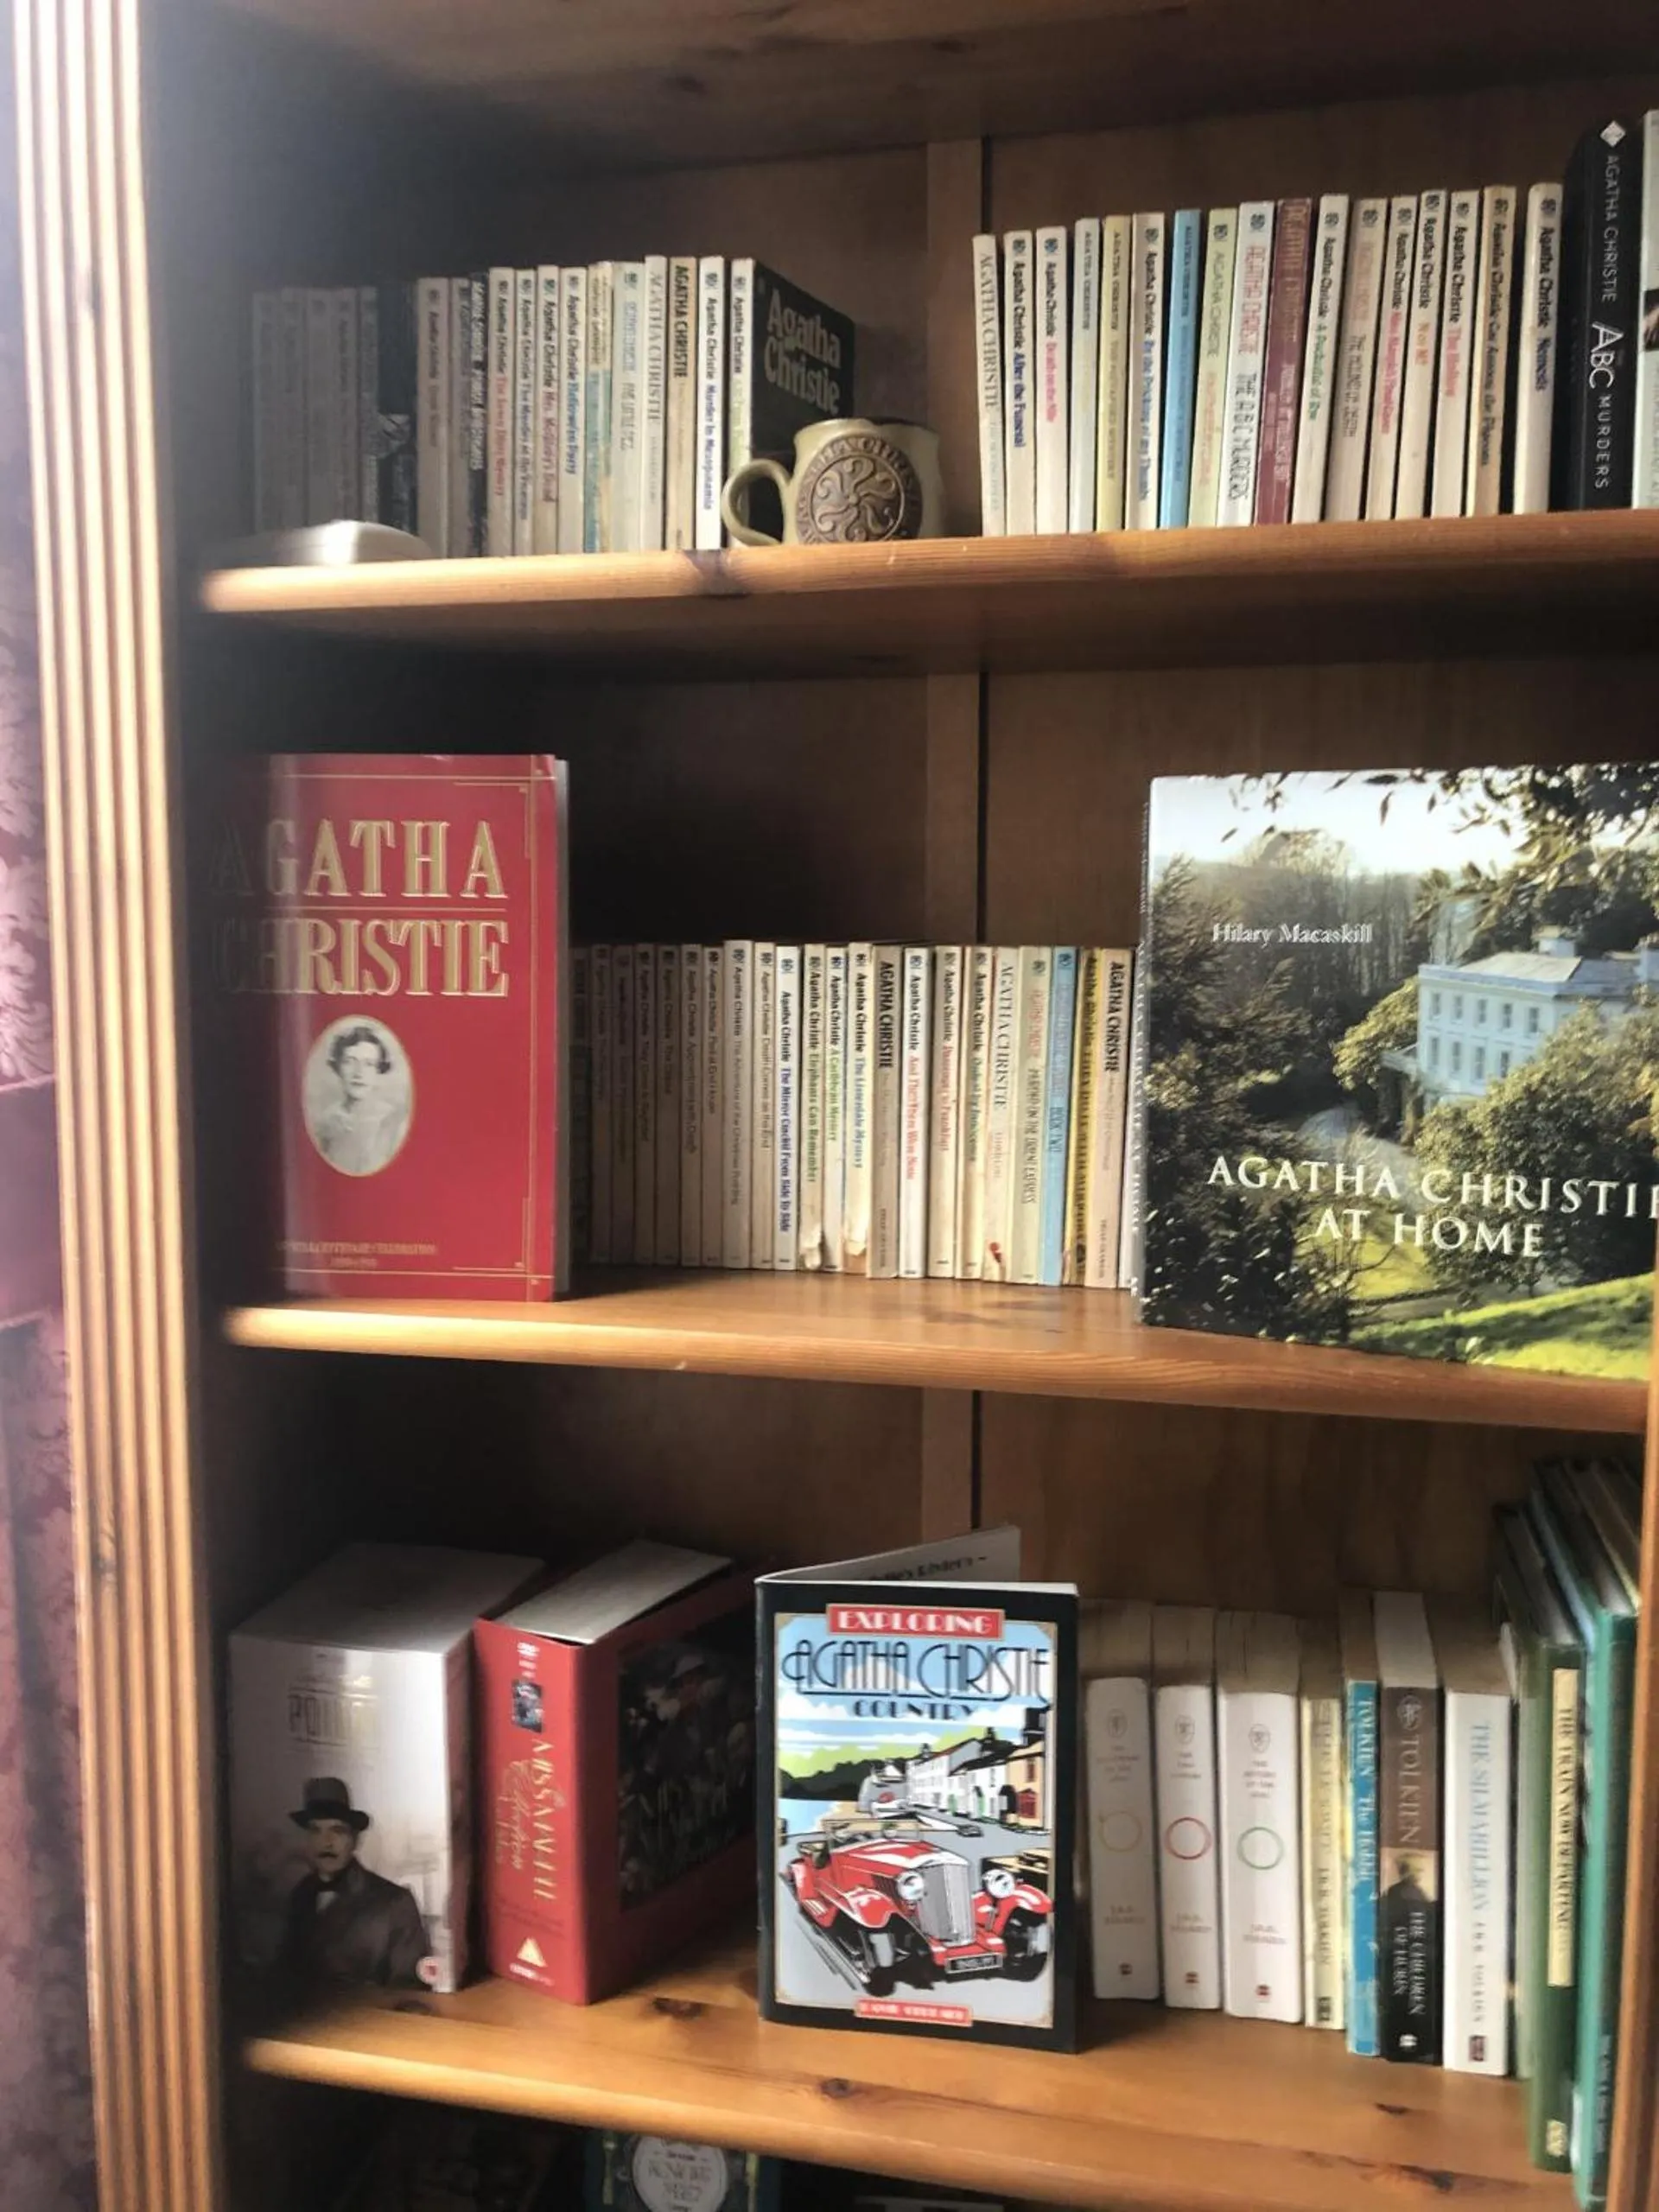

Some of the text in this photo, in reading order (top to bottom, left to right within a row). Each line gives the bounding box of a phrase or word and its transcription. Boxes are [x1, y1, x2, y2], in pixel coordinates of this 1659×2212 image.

[1452, 226, 1471, 270] Agatha
[674, 264, 693, 319] AGATHA
[980, 251, 998, 326] AGATHA
[1013, 261, 1027, 304] Agatha
[1448, 273, 1465, 324] Christie
[1532, 226, 1556, 392] Agatha Christie Nemesis
[672, 320, 692, 379] CHRISTIE
[766, 287, 842, 370] Agatha
[1014, 305, 1027, 350] Christie
[1588, 154, 1626, 490] AGATHA CHRISTIE ABC MURDERS
[764, 335, 842, 416] Christie
[209, 817, 508, 899] AGATHA
[212, 918, 509, 999] CHRISTIE
[1212, 922, 1373, 950] Hilary Macaskill
[853, 971, 868, 1011] Agatha
[880, 960, 897, 1012] AGATHA
[908, 974, 923, 1011] Agatha
[1108, 961, 1127, 1014] AGATHA
[854, 1012, 868, 1052] Christie
[879, 1014, 895, 1069] CHRISTIE
[909, 1012, 922, 1051] Christie
[1104, 1015, 1125, 1073] CHRISTIE
[1207, 1154, 1401, 1200] AGATHA
[1313, 1208, 1545, 1259] AT HOME
[836, 1610, 993, 1637] EXPLORING
[781, 1638, 1051, 1703] AGATHA CHRISTIE
[853, 1700, 976, 1720] COUNTRY
[1471, 1723, 1491, 1765] THE
[1357, 1698, 1377, 1883] TOLKIEN The Hobbit
[1396, 1733, 1423, 1844] TOLKIEN
[1556, 1707, 1574, 1839] THE TRAIN NOW
[1470, 1768, 1490, 1913] SILMARILLION
[1408, 1941, 1427, 2016] CHILDREN
